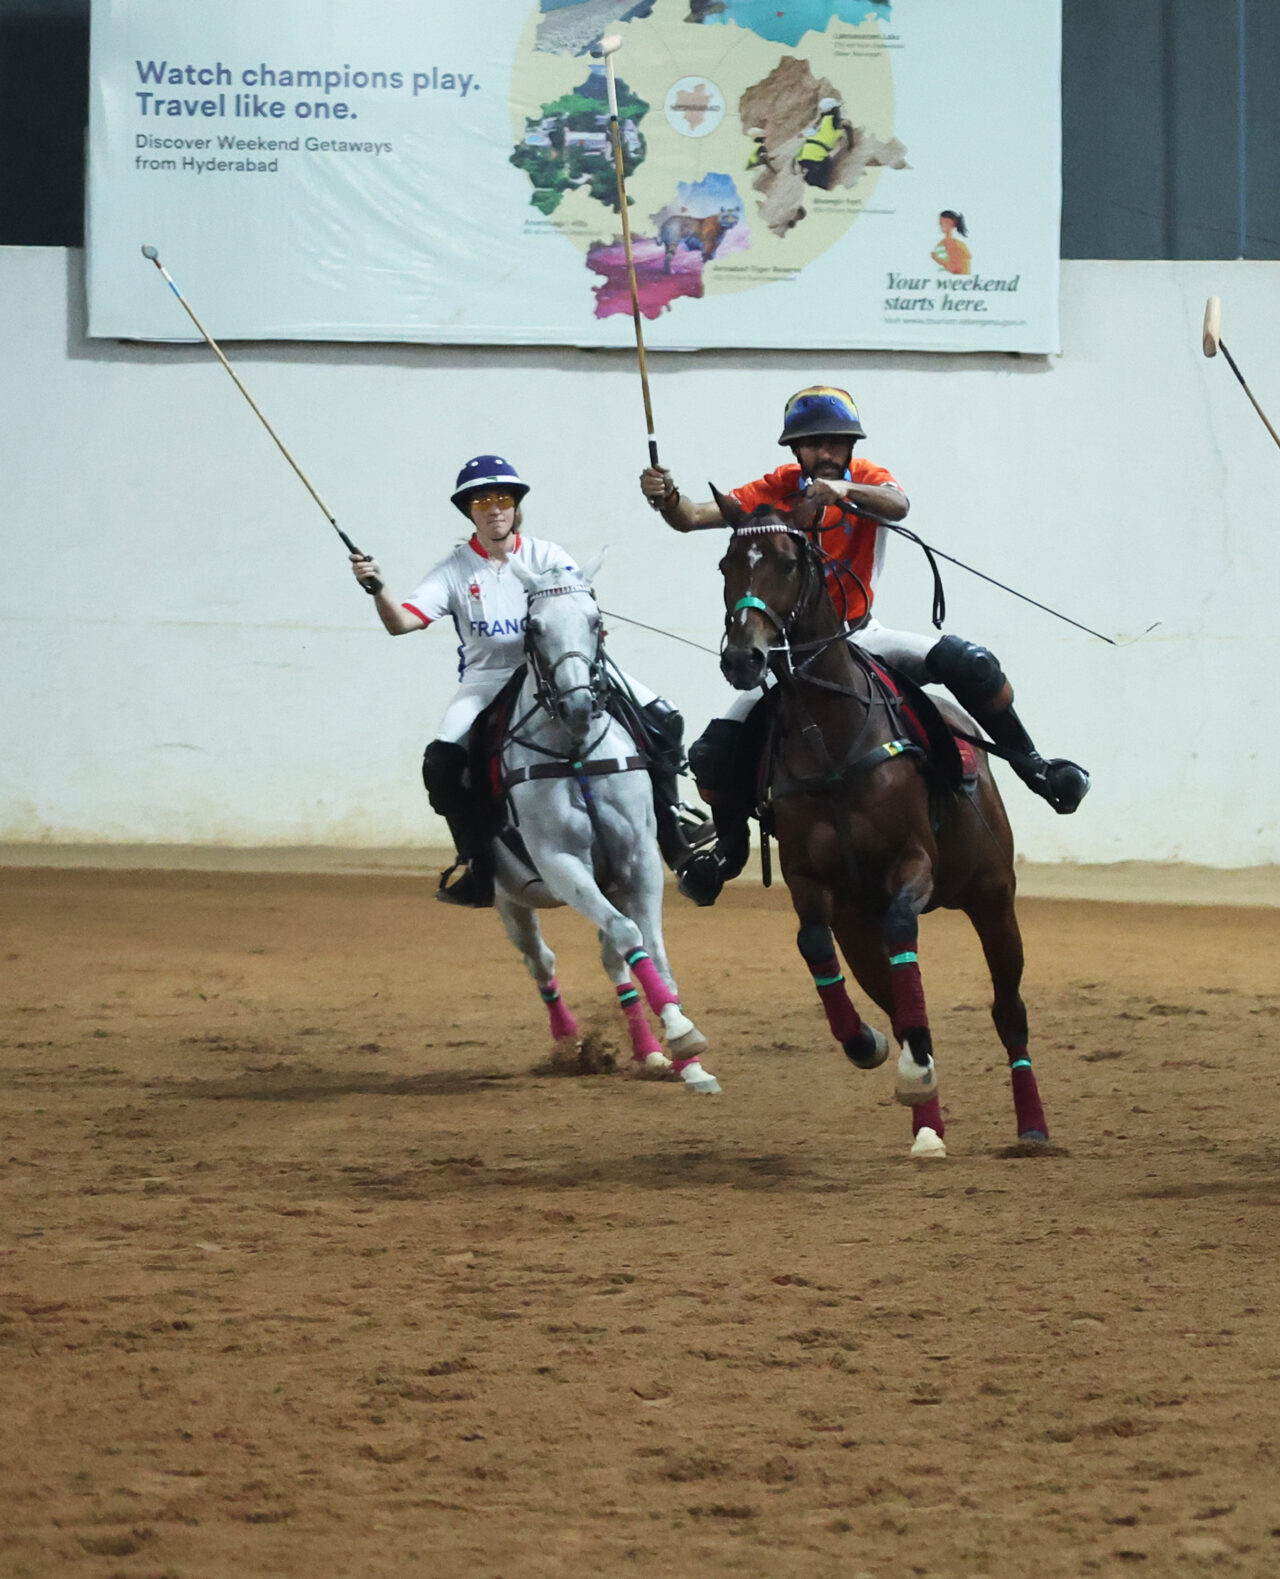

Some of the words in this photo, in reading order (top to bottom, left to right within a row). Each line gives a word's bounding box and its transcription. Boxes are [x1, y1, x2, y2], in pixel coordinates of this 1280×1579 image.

[135, 60, 232, 86] Watch
[241, 63, 404, 95] champions
[412, 66, 481, 97] play.
[135, 91, 225, 117] Travel
[235, 93, 286, 118] like
[295, 101, 358, 120] one.
[135, 133, 212, 149] Discover
[216, 135, 300, 151] Weekend
[304, 136, 393, 156] Getaways
[135, 155, 177, 170] from
[181, 156, 279, 175] Hyderabad
[886, 272, 931, 291] Your
[935, 273, 1021, 292] weekend
[884, 295, 936, 312] starts
[940, 293, 989, 312] here.
[470, 617, 529, 638] FRANC
